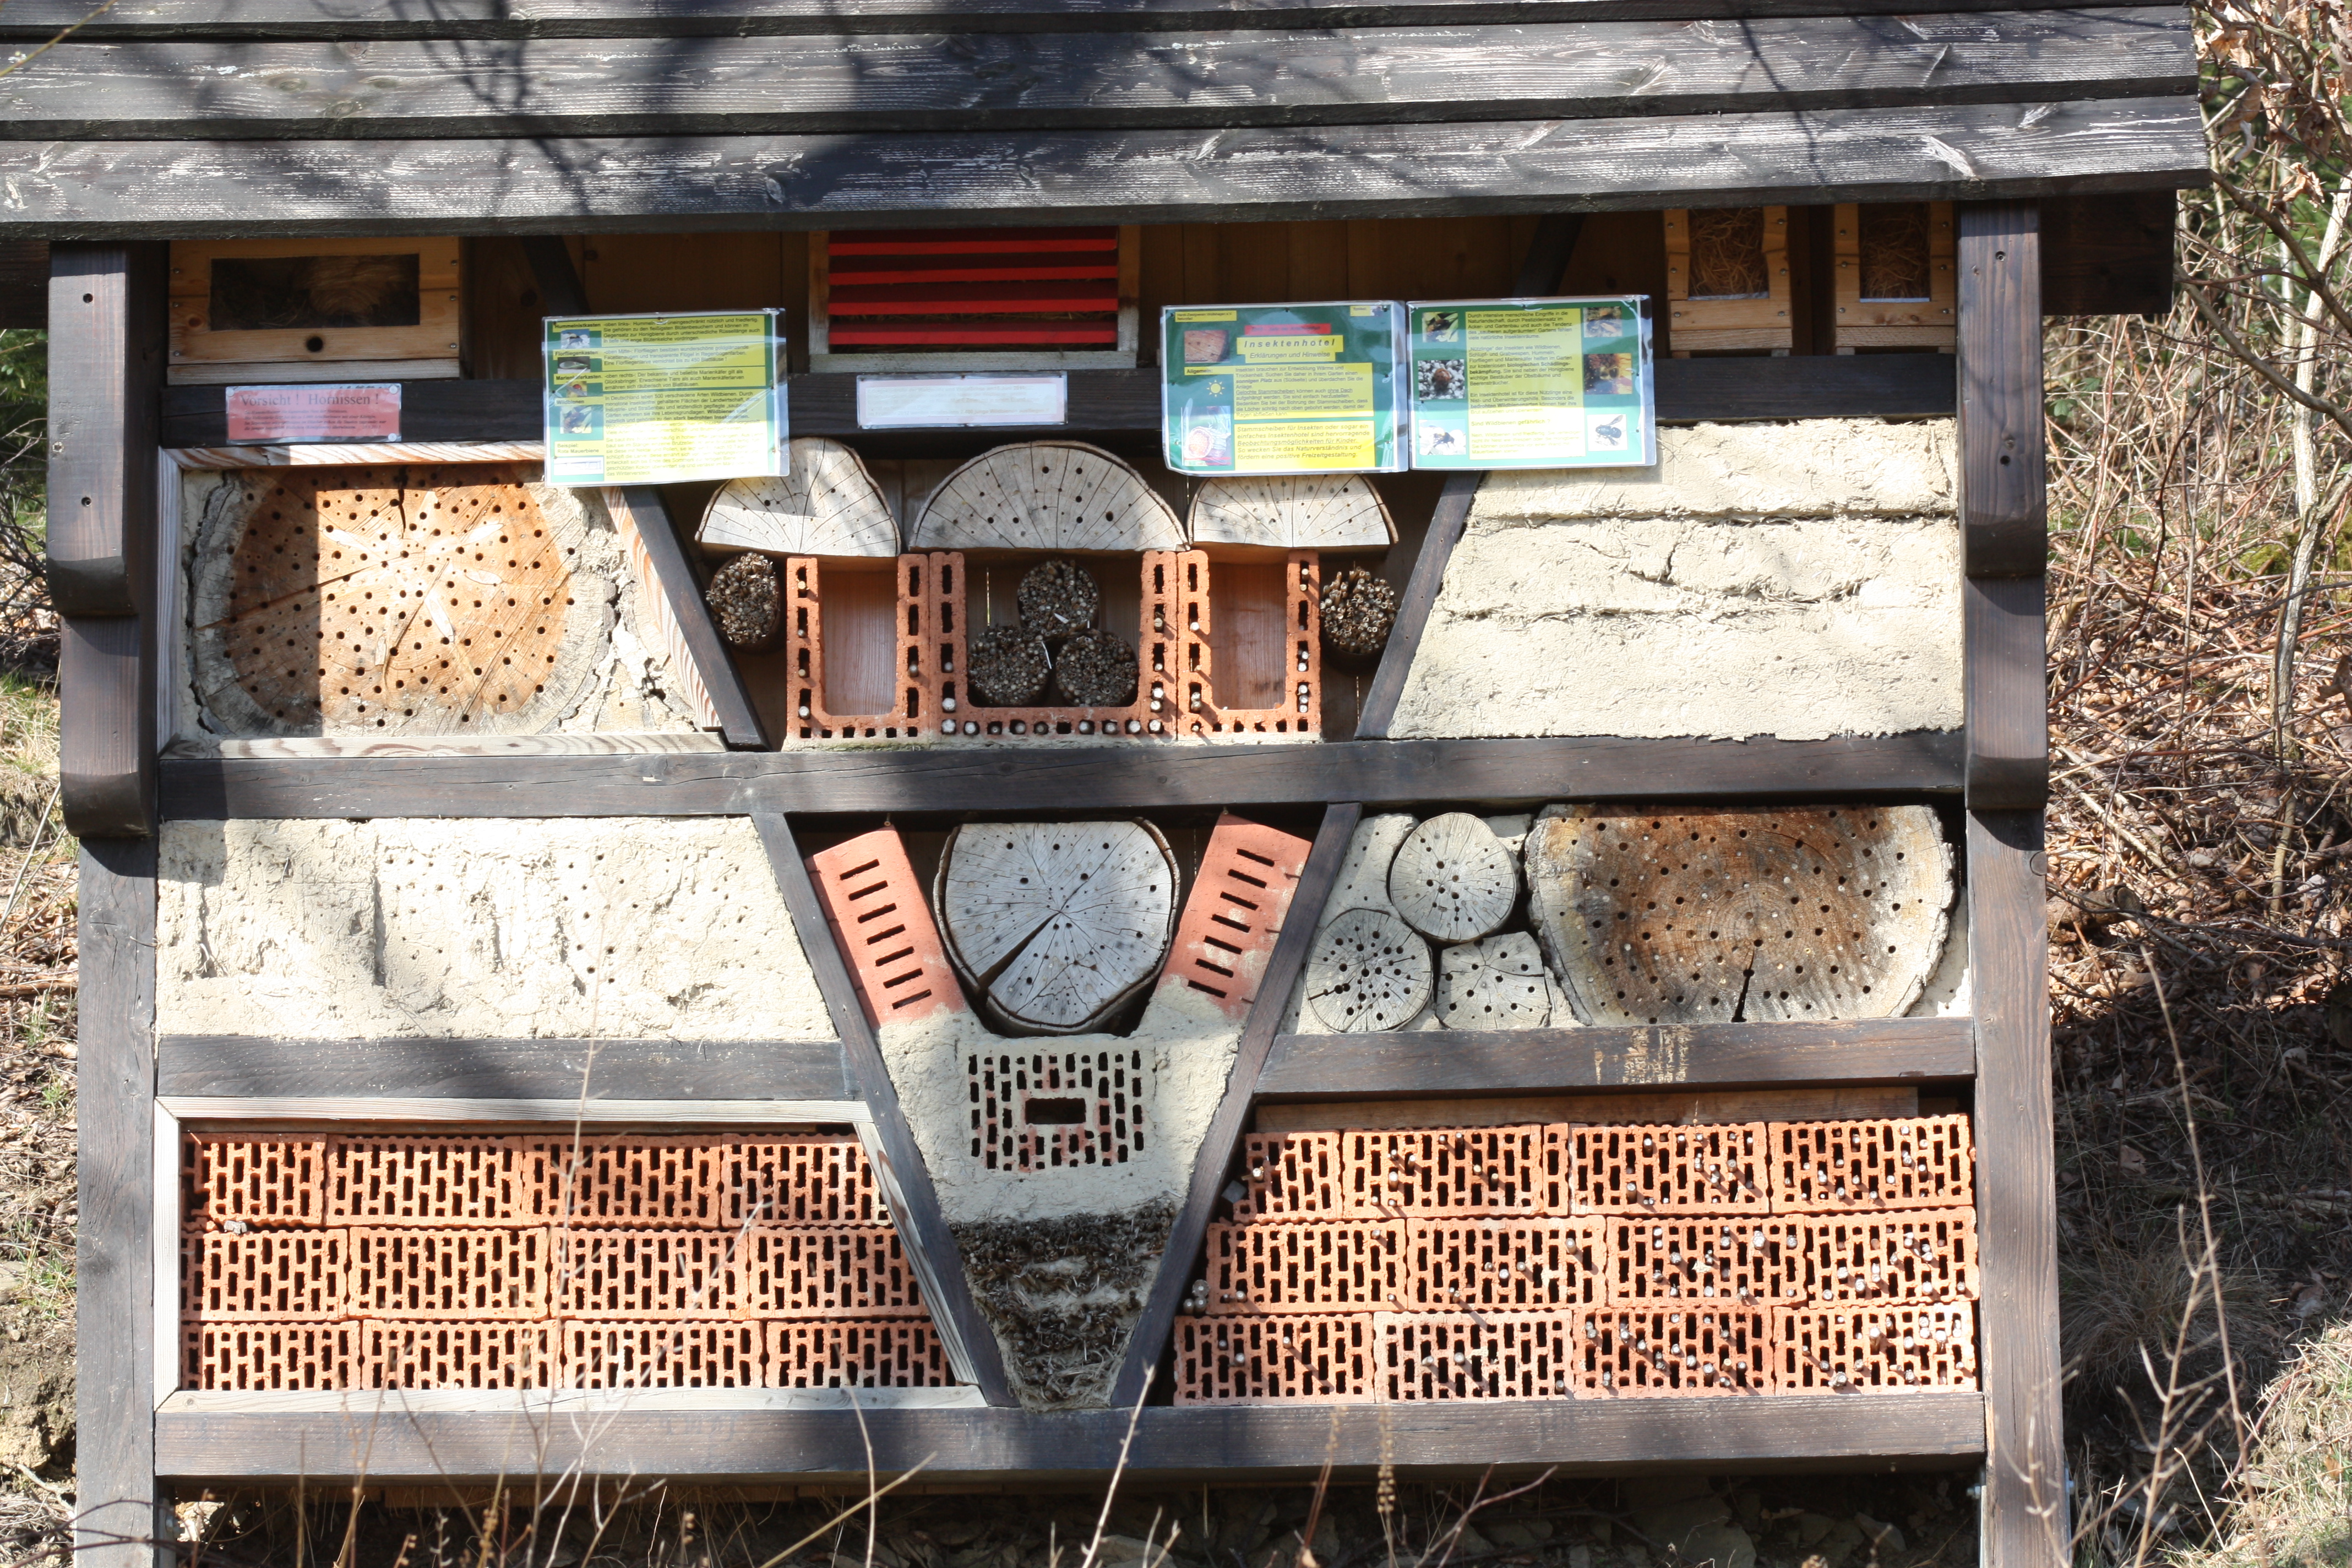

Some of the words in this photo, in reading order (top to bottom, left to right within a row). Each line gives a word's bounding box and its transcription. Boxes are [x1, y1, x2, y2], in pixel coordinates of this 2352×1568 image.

[1244, 339, 1335, 348] Insektenhotel
[241, 394, 291, 405] Vorsicht
[296, 394, 299, 405] !
[309, 393, 370, 405] Hornissen
[375, 394, 379, 405] !
[1237, 438, 1324, 447] Beobachtungsmöglichkeiten
